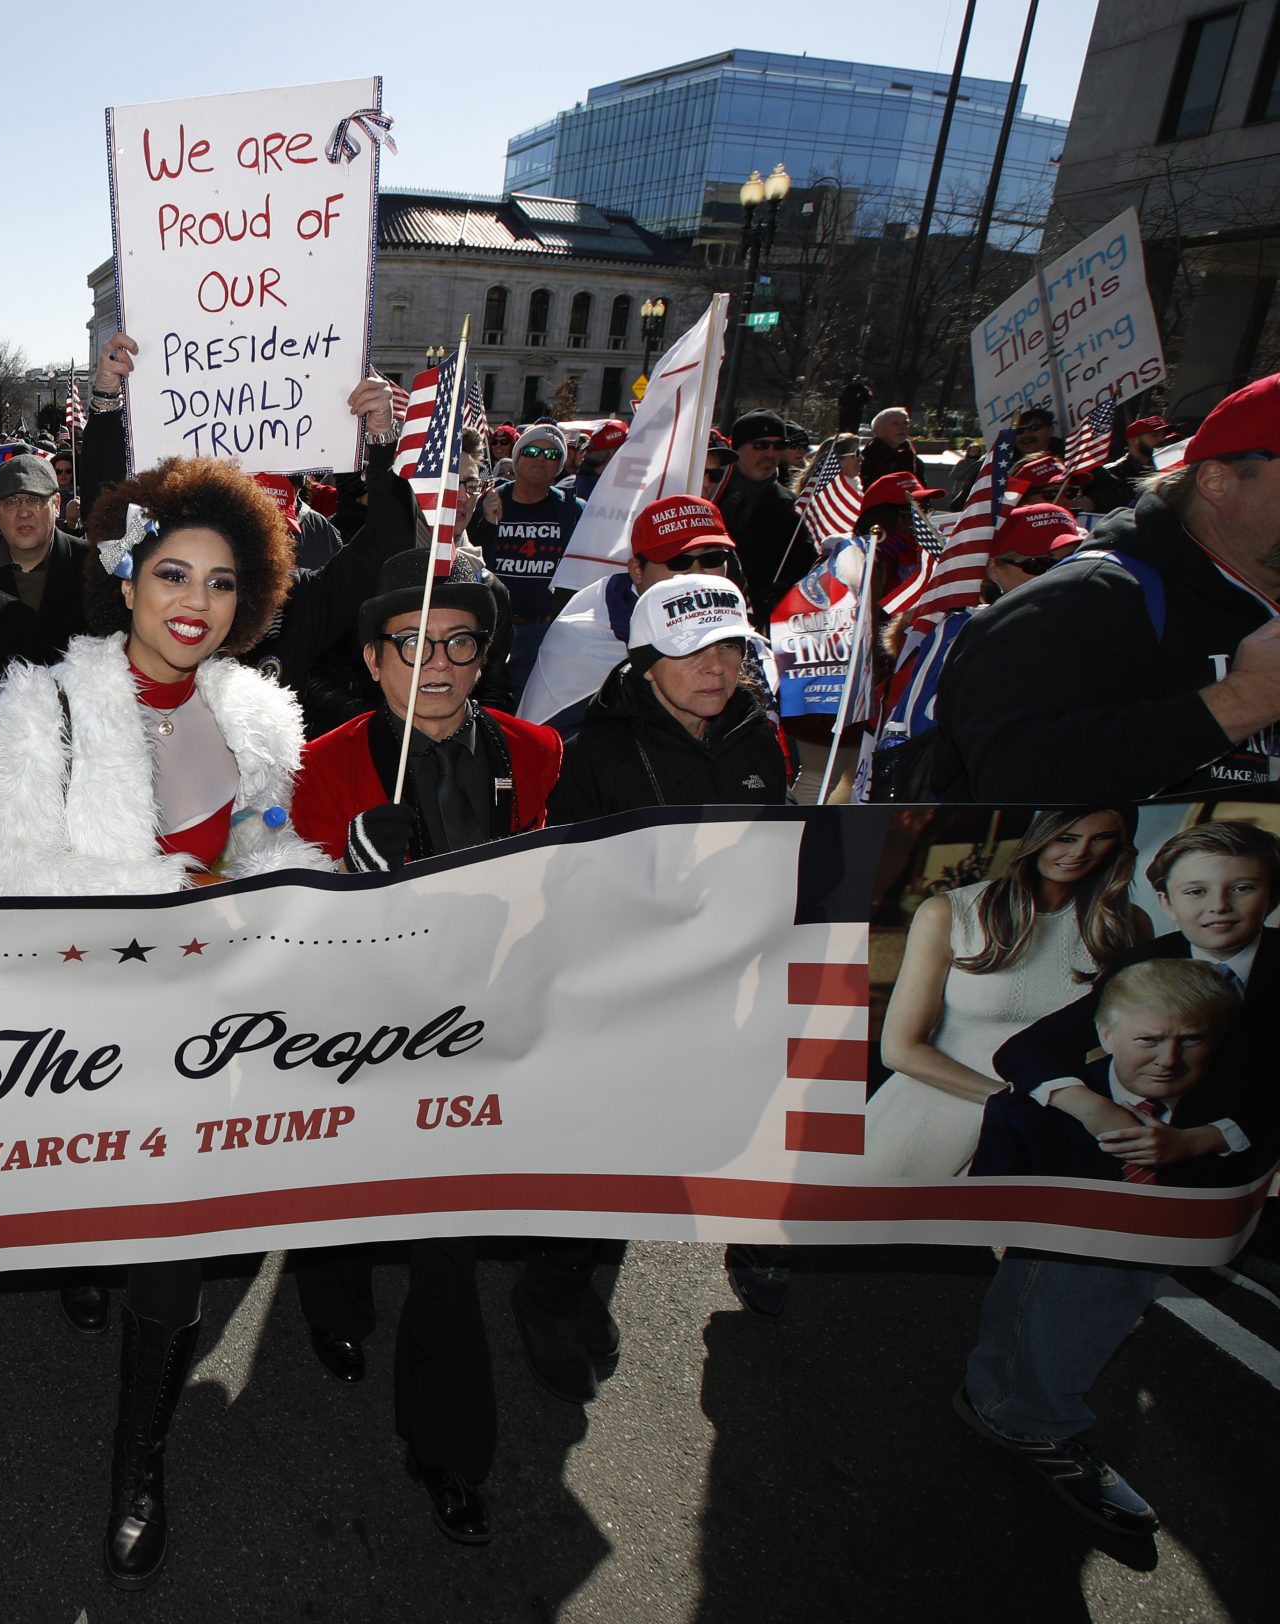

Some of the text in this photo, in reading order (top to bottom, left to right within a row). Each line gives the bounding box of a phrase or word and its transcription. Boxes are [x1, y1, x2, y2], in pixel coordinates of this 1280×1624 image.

[143, 124, 214, 181] We
[198, 268, 287, 313] OUR
[1065, 356, 1109, 393] For
[160, 378, 303, 426] DONALD
[183, 414, 313, 458] TRUMP
[652, 505, 713, 525] MAKE AMERICA
[658, 519, 688, 536] GREAT
[498, 525, 561, 539] MARCH
[520, 539, 537, 557] 4
[663, 592, 739, 619] TRUMP
[666, 617, 683, 628] MAKE
[685, 609, 712, 621] AMERICA
[698, 615, 723, 625] 2016
[1210, 766, 1252, 781] MAKE
[174, 1005, 485, 1085] People
[139, 1126, 168, 1159] 4
[195, 1105, 356, 1154] TRUMP
[414, 1093, 503, 1131] USA
